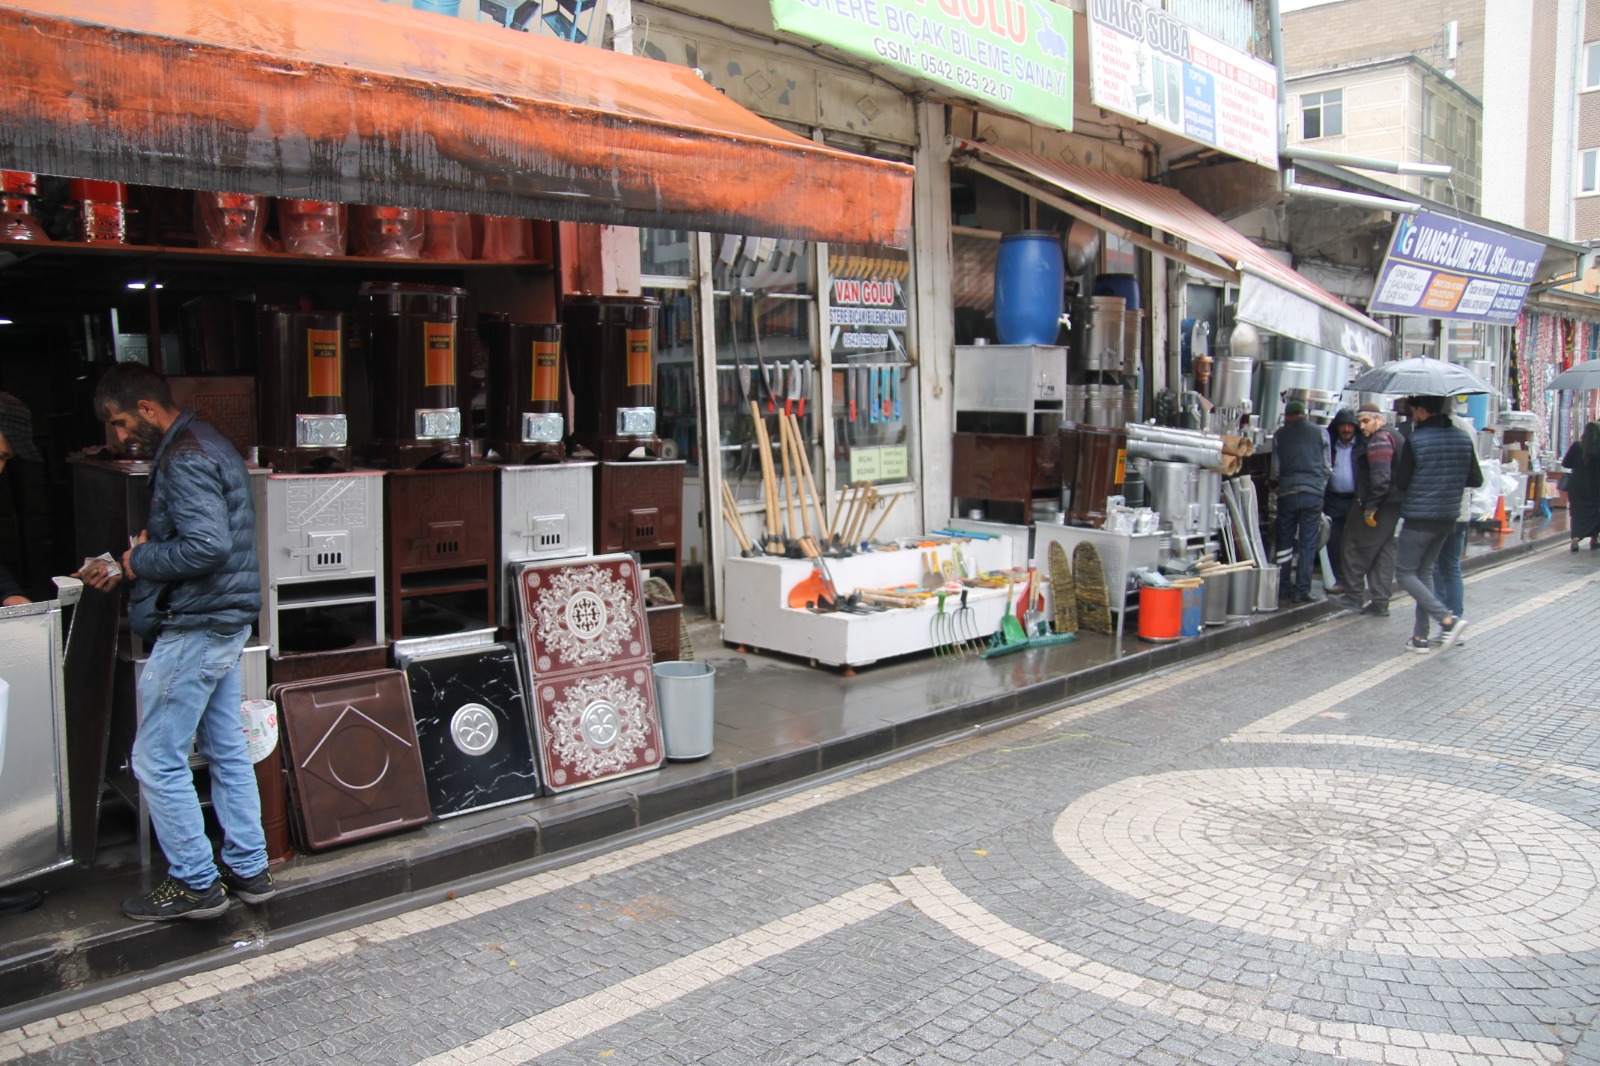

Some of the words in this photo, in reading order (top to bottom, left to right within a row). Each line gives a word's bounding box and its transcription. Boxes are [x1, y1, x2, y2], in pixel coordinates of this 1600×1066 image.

[884, 5, 945, 49] BIÇAK
[951, 25, 1011, 75] BİLEME
[1015, 56, 1067, 97] SANAYİ
[1147, 10, 1191, 60] SOBA
[873, 37, 917, 67] GSM:
[921, 54, 953, 80] 0542
[957, 66, 979, 90] 625
[982, 76, 997, 96] 22
[1000, 83, 1014, 102] 07
[835, 279, 860, 303] VAN
[862, 276, 894, 305] GÖLÜ
[843, 333, 859, 347] 0542
